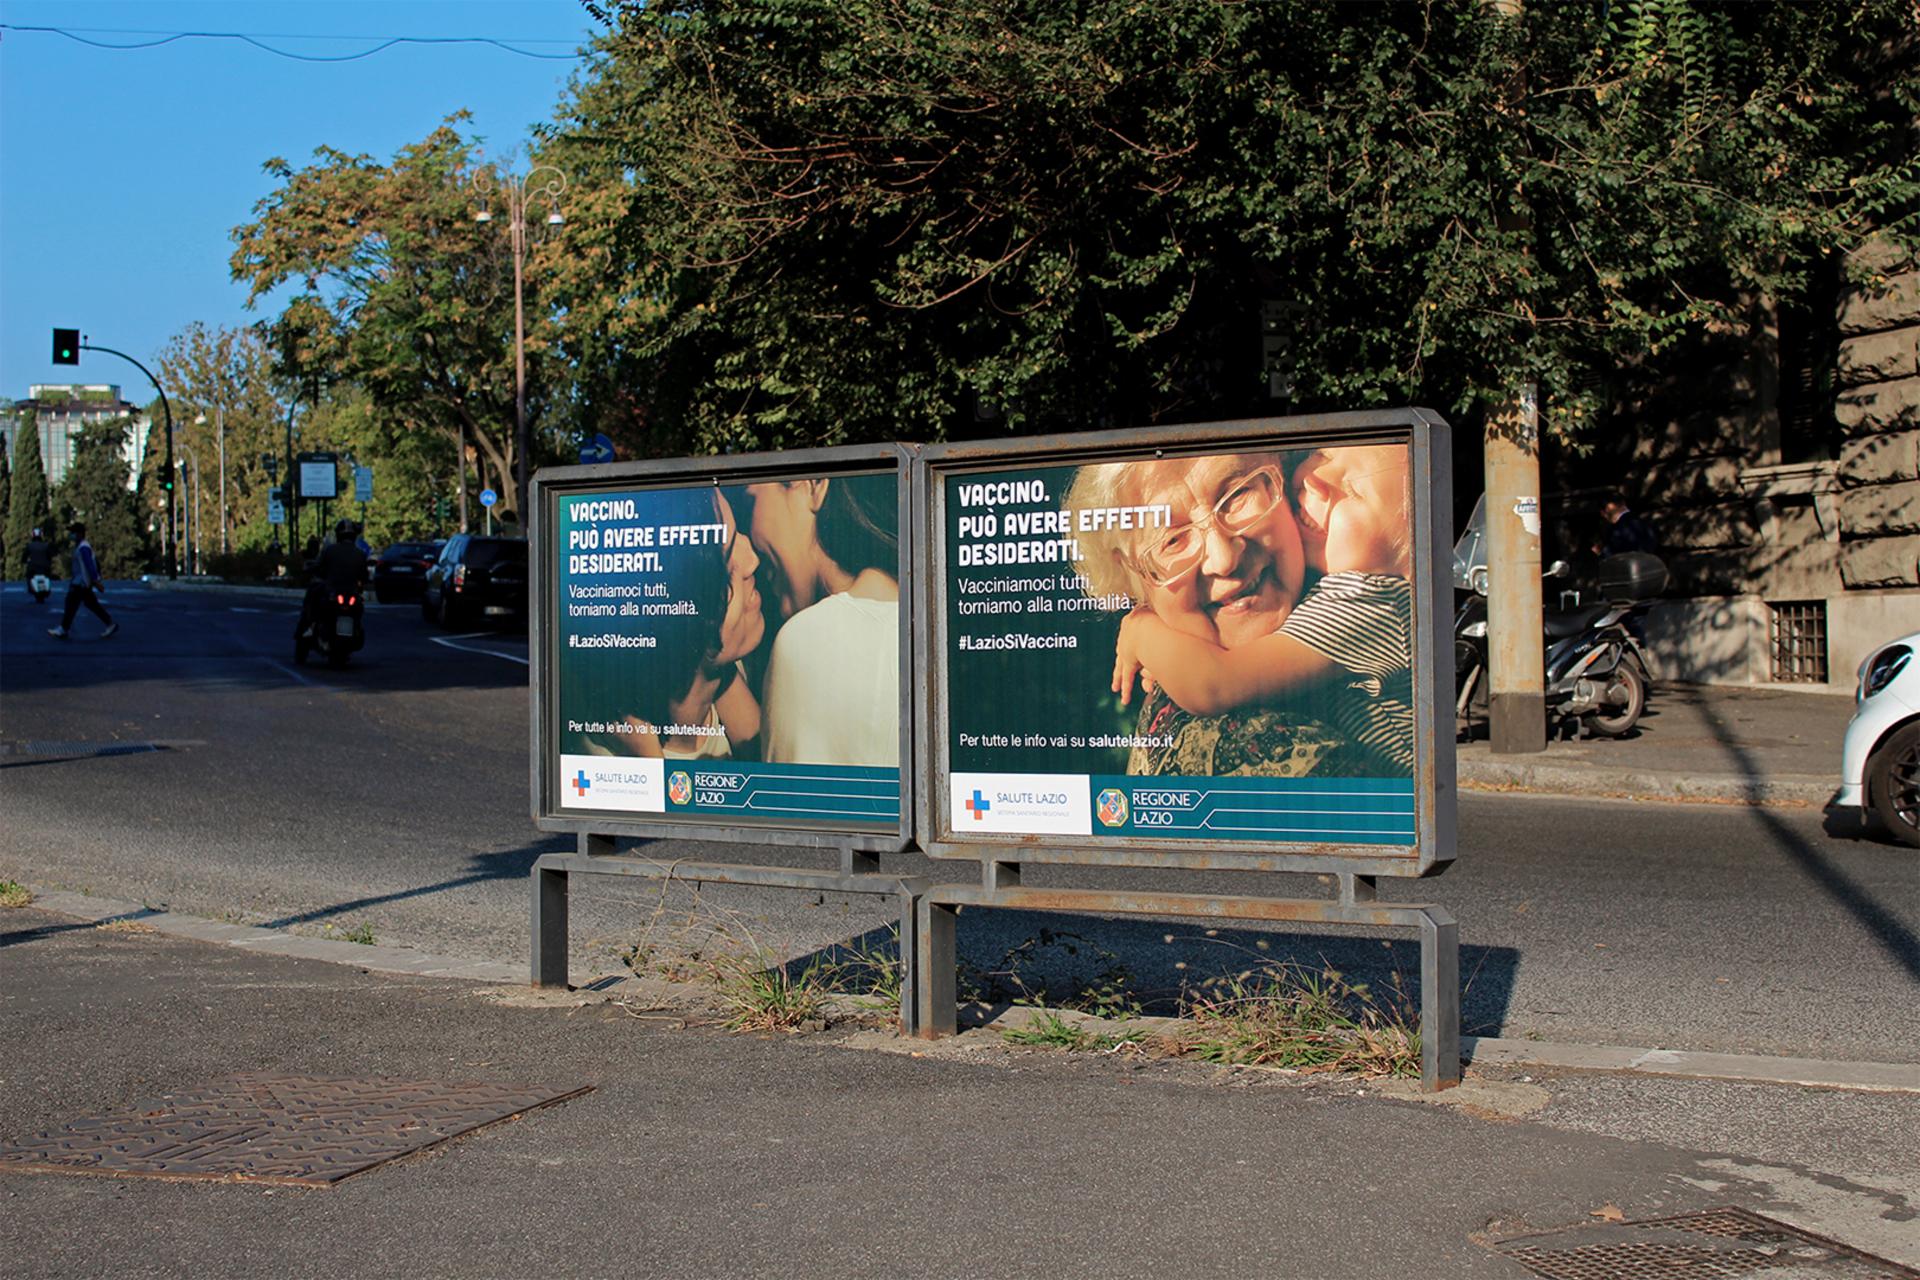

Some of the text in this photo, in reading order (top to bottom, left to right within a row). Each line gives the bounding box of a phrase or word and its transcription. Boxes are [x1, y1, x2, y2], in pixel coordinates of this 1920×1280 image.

[958, 479, 1050, 507] VACCINO.
[569, 499, 639, 522] VACCINO.
[958, 505, 1171, 538] PUÒ AVERE EFFETTI
[569, 523, 728, 550] PUÒ AVERE EFFETTI
[958, 539, 1085, 566] DESIDERATI.
[569, 552, 663, 574] DESIDERATI.
[569, 582, 671, 599] Vacciniamoci tutti,
[958, 574, 1094, 594] Vacciniamoci tutti,
[569, 600, 700, 616] torniamo alla normalità.
[958, 592, 1135, 615] torniamo alla normalità.
[568, 720, 726, 737] Per tutte le info vai su salutelazio.it
[959, 733, 1174, 748] Per tutte le info vai su salutelazio.it
[594, 772, 648, 785] SALUTE LAZIO
[694, 774, 739, 789] REGIONE
[694, 791, 726, 805] LAZIO
[997, 792, 1068, 805] SALUTE LAZIO
[1132, 792, 1191, 807] REGIONE
[1133, 812, 1173, 825] LAZIO
